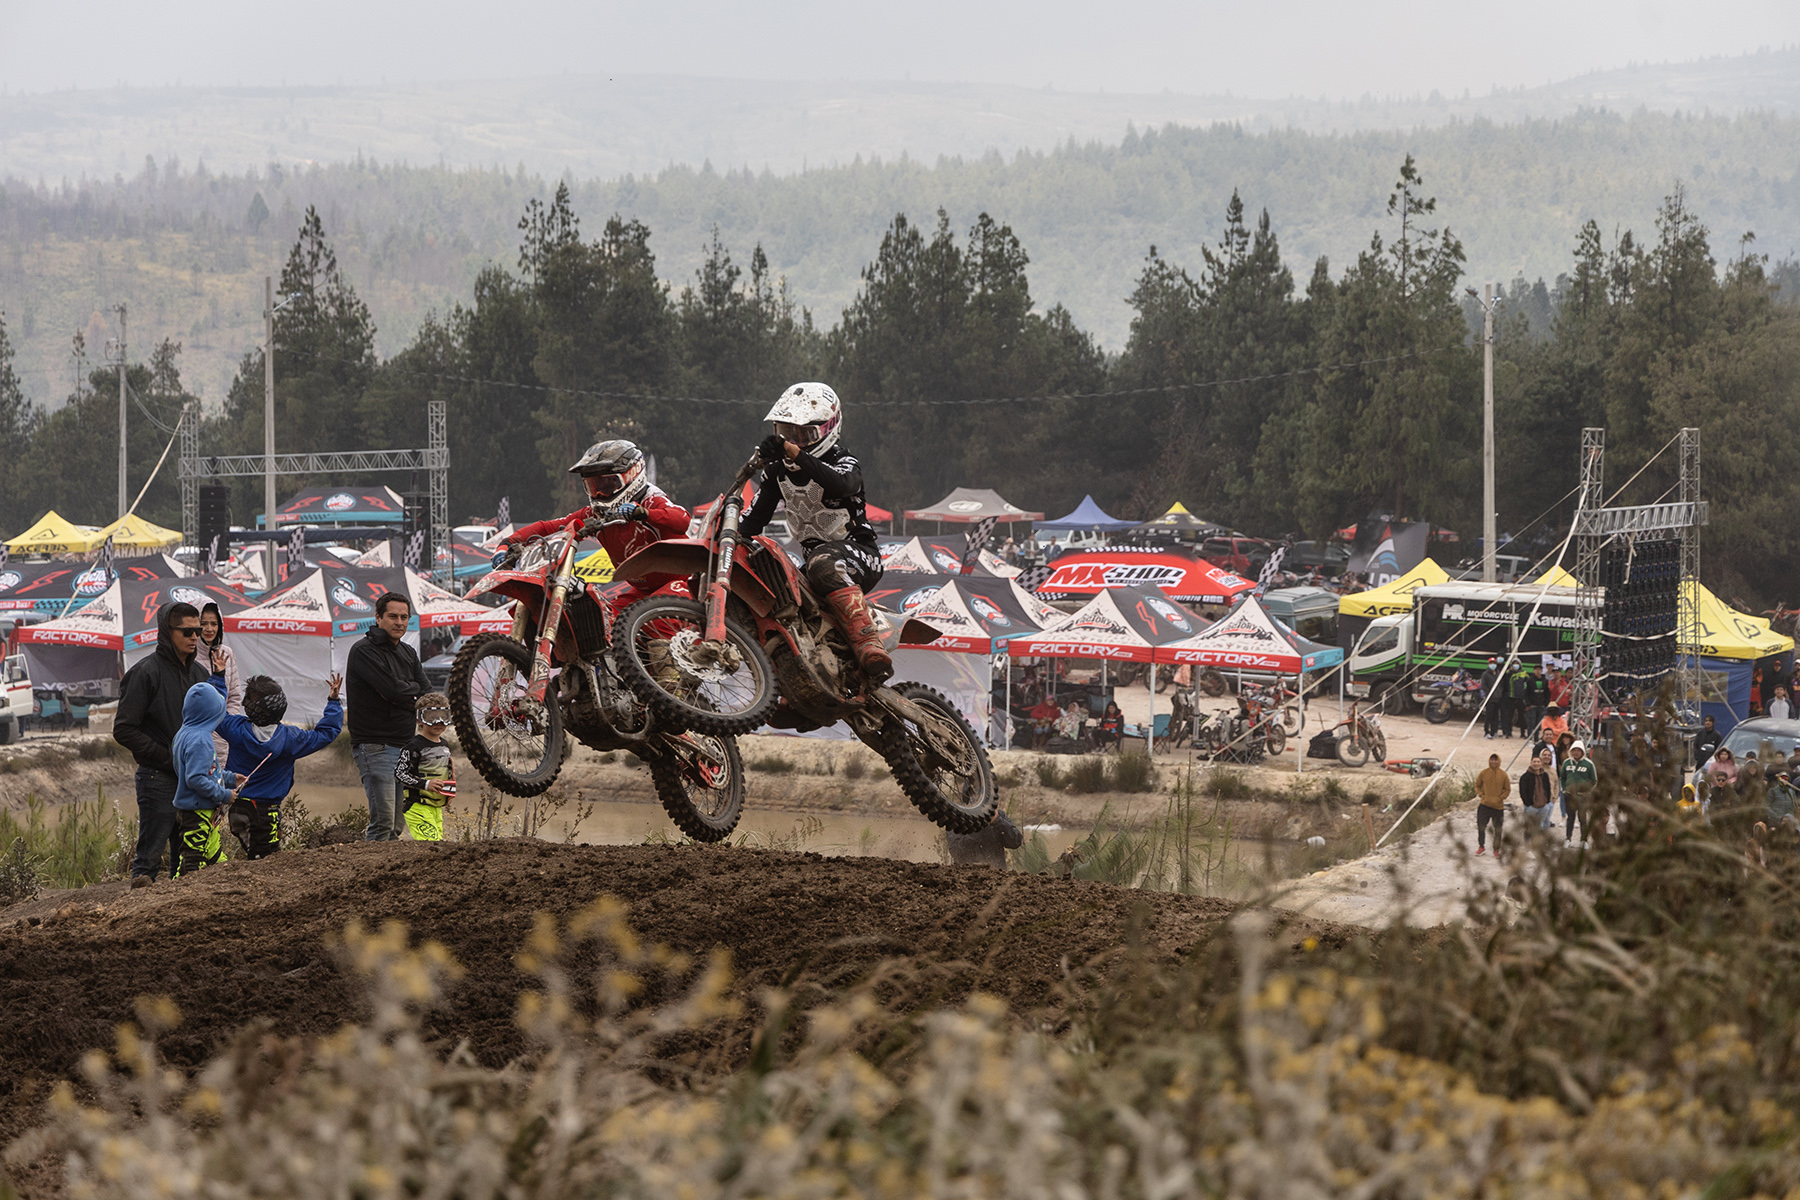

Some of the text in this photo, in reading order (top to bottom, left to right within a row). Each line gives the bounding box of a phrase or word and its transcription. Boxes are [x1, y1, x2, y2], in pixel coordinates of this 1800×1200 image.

[16, 543, 69, 553] ACERBIS
[237, 620, 309, 632] FACTORY
[478, 622, 514, 632] FAC
[32, 630, 99, 644] FACTORY
[1028, 643, 1120, 657] FACTORY
[1174, 651, 1269, 667] FACTORY
